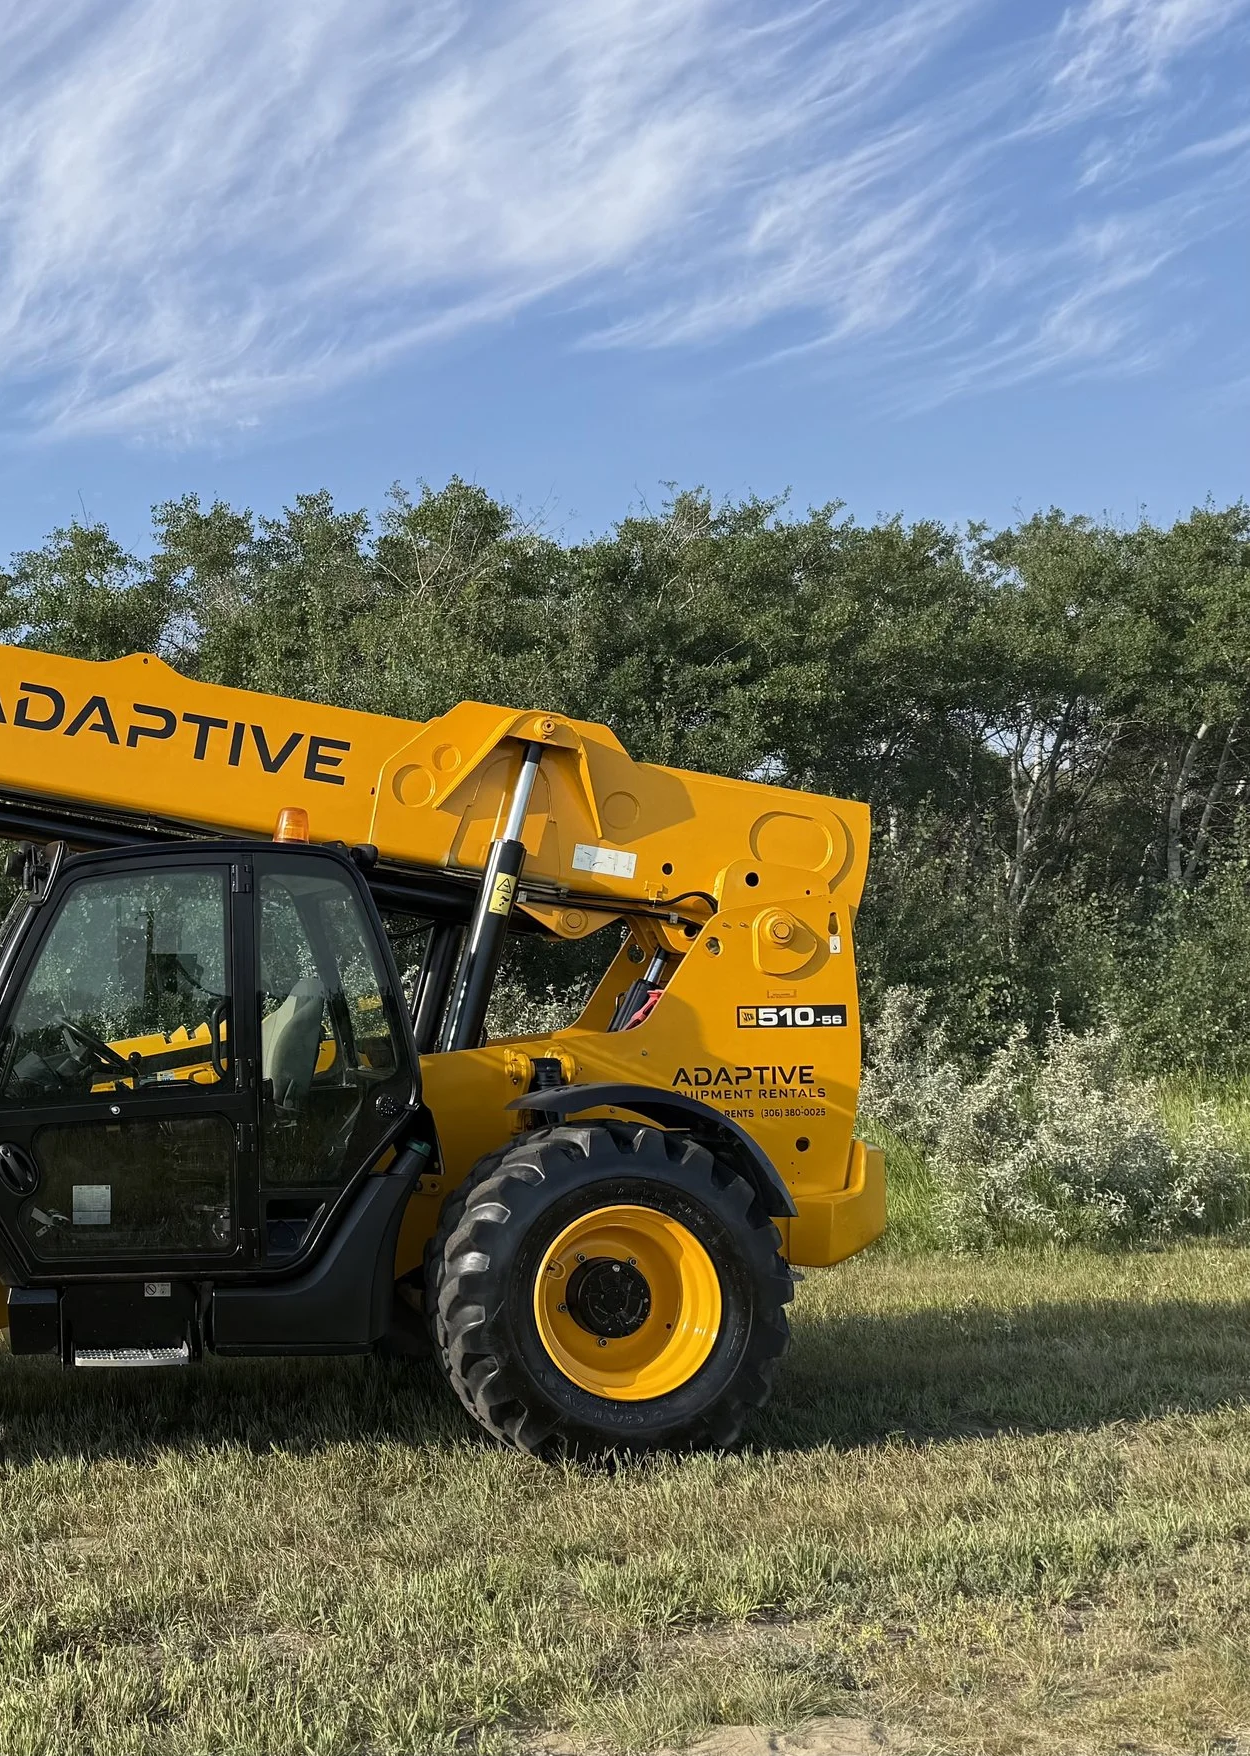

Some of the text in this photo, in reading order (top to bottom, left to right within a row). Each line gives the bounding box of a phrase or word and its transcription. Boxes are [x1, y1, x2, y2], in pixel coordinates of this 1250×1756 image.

[758, 1007, 843, 1026] 510-56
[672, 1066, 815, 1086] ADAPTIVE
[759, 1088, 826, 1099] RENTALS
[761, 1108, 783, 1119] (306)
[785, 1107, 826, 1117] 380-0025
